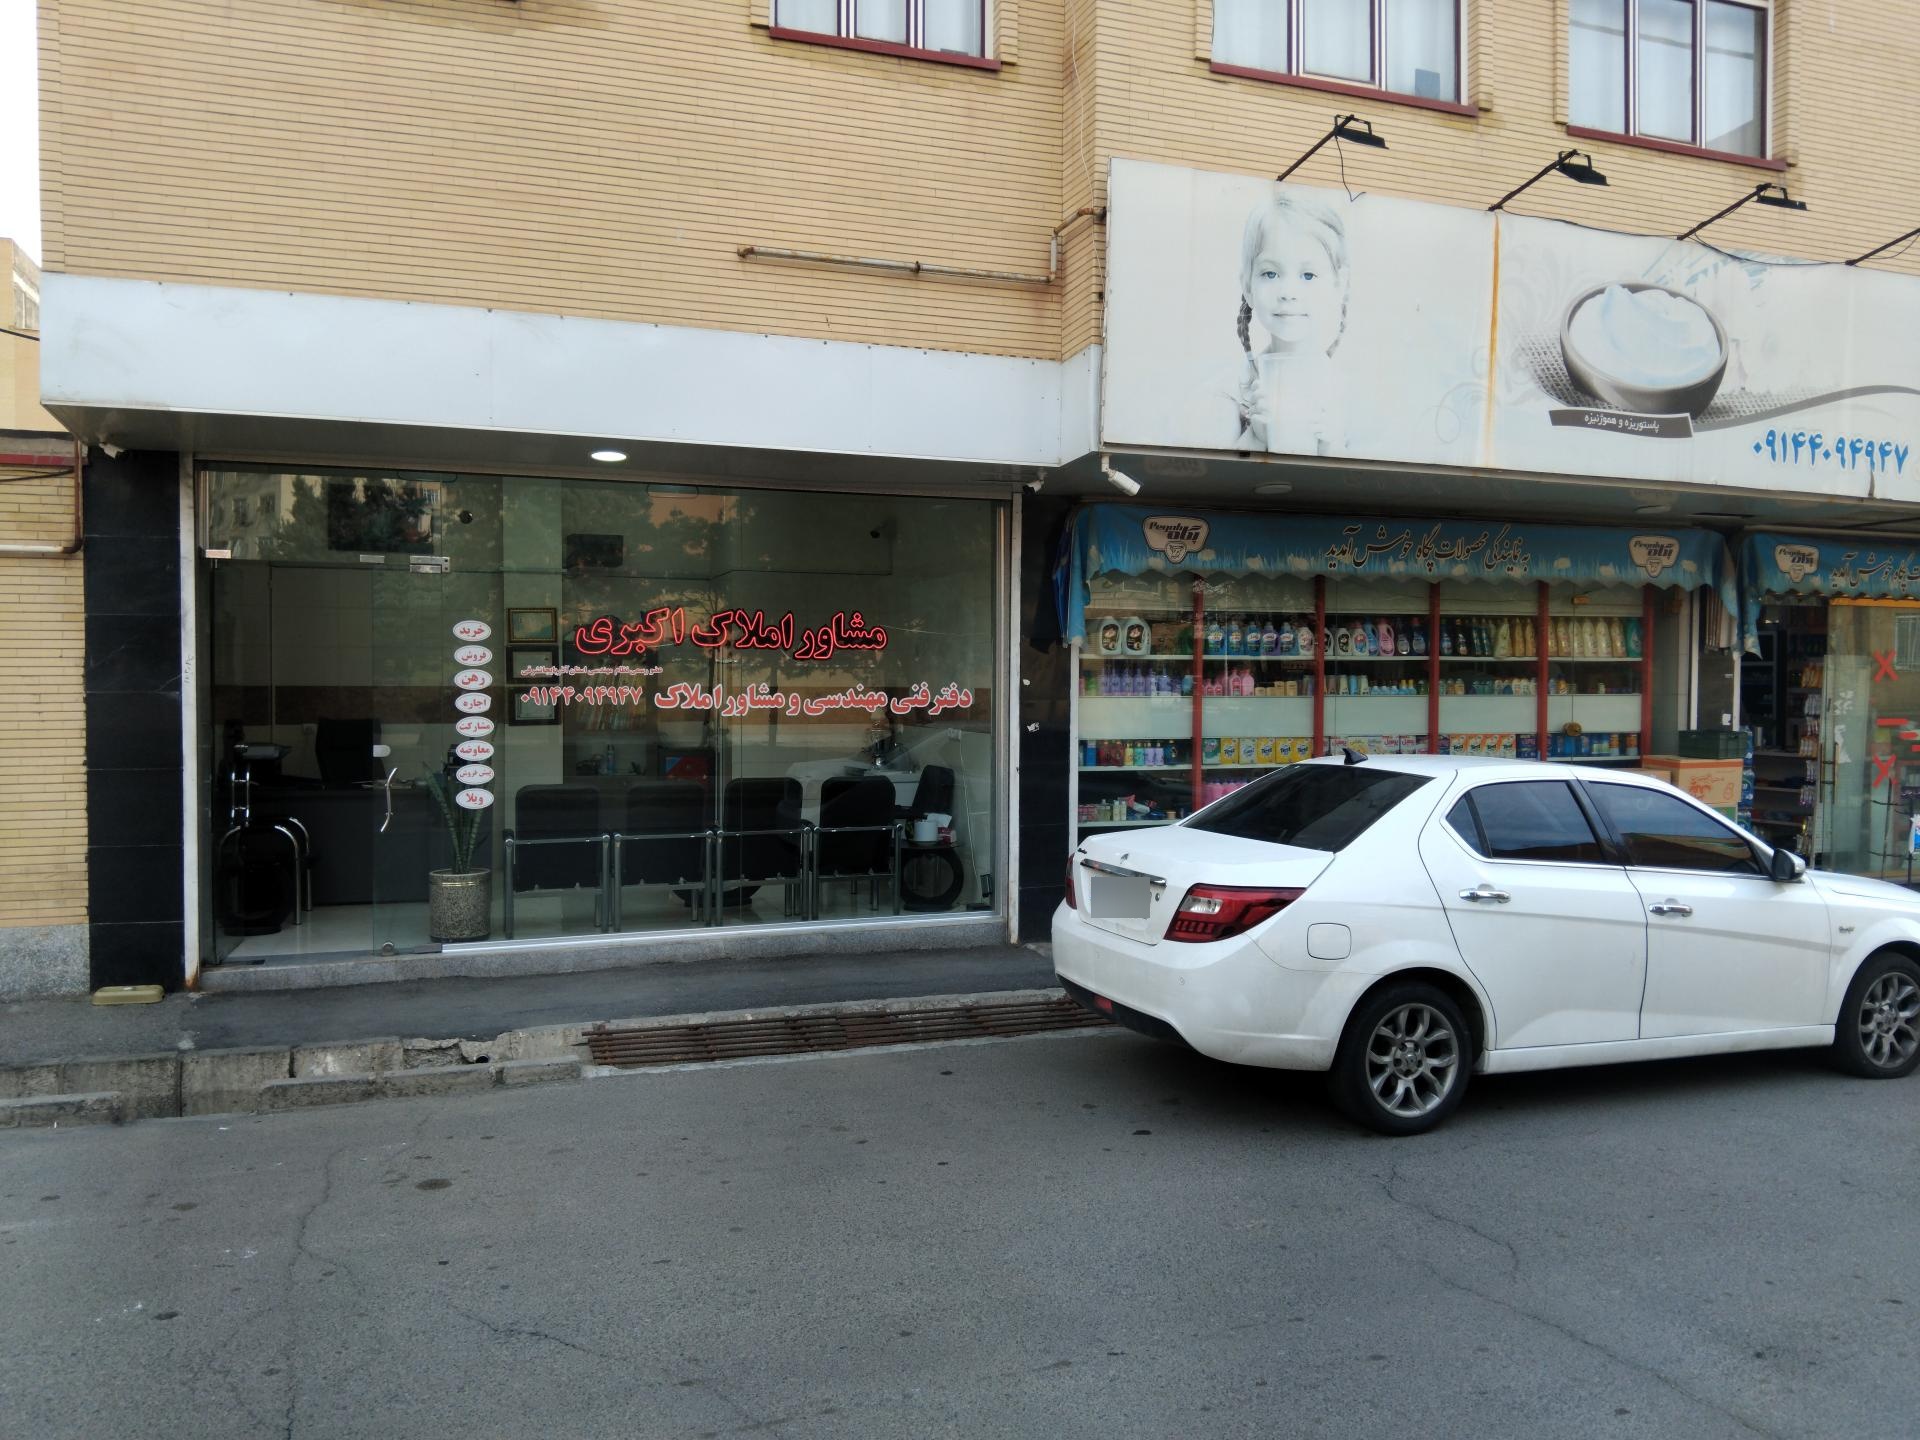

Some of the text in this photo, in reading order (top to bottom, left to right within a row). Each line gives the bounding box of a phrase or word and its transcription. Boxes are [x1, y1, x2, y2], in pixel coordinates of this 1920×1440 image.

[1584, 412, 1617, 425] هموژنیزه
[1625, 419, 1660, 433] پاستوریزه
[1752, 429, 1909, 475] ۰۹۱۴۴۰۹۴۹۴۷
[1325, 524, 1362, 569] آمدید
[1352, 525, 1413, 568] خوش
[1415, 523, 1442, 573] پگاه
[1434, 531, 1490, 561] محصولات
[459, 625, 485, 638] خرید
[576, 606, 888, 659] مشاور املاک اکبری
[461, 651, 487, 662] فروش
[587, 666, 614, 676] مهندسی
[461, 674, 486, 686] رهن
[463, 698, 487, 710] اجاره
[520, 681, 973, 717] دفتر فنی مهندسی و مشاور املاک ۰۹۱۴۴۰۹۴۹۴۷
[459, 721, 491, 733] مشارکت
[459, 745, 491, 757] معاوضه
[459, 769, 492, 778] پیش فروش
[465, 792, 485, 806] ویلا
